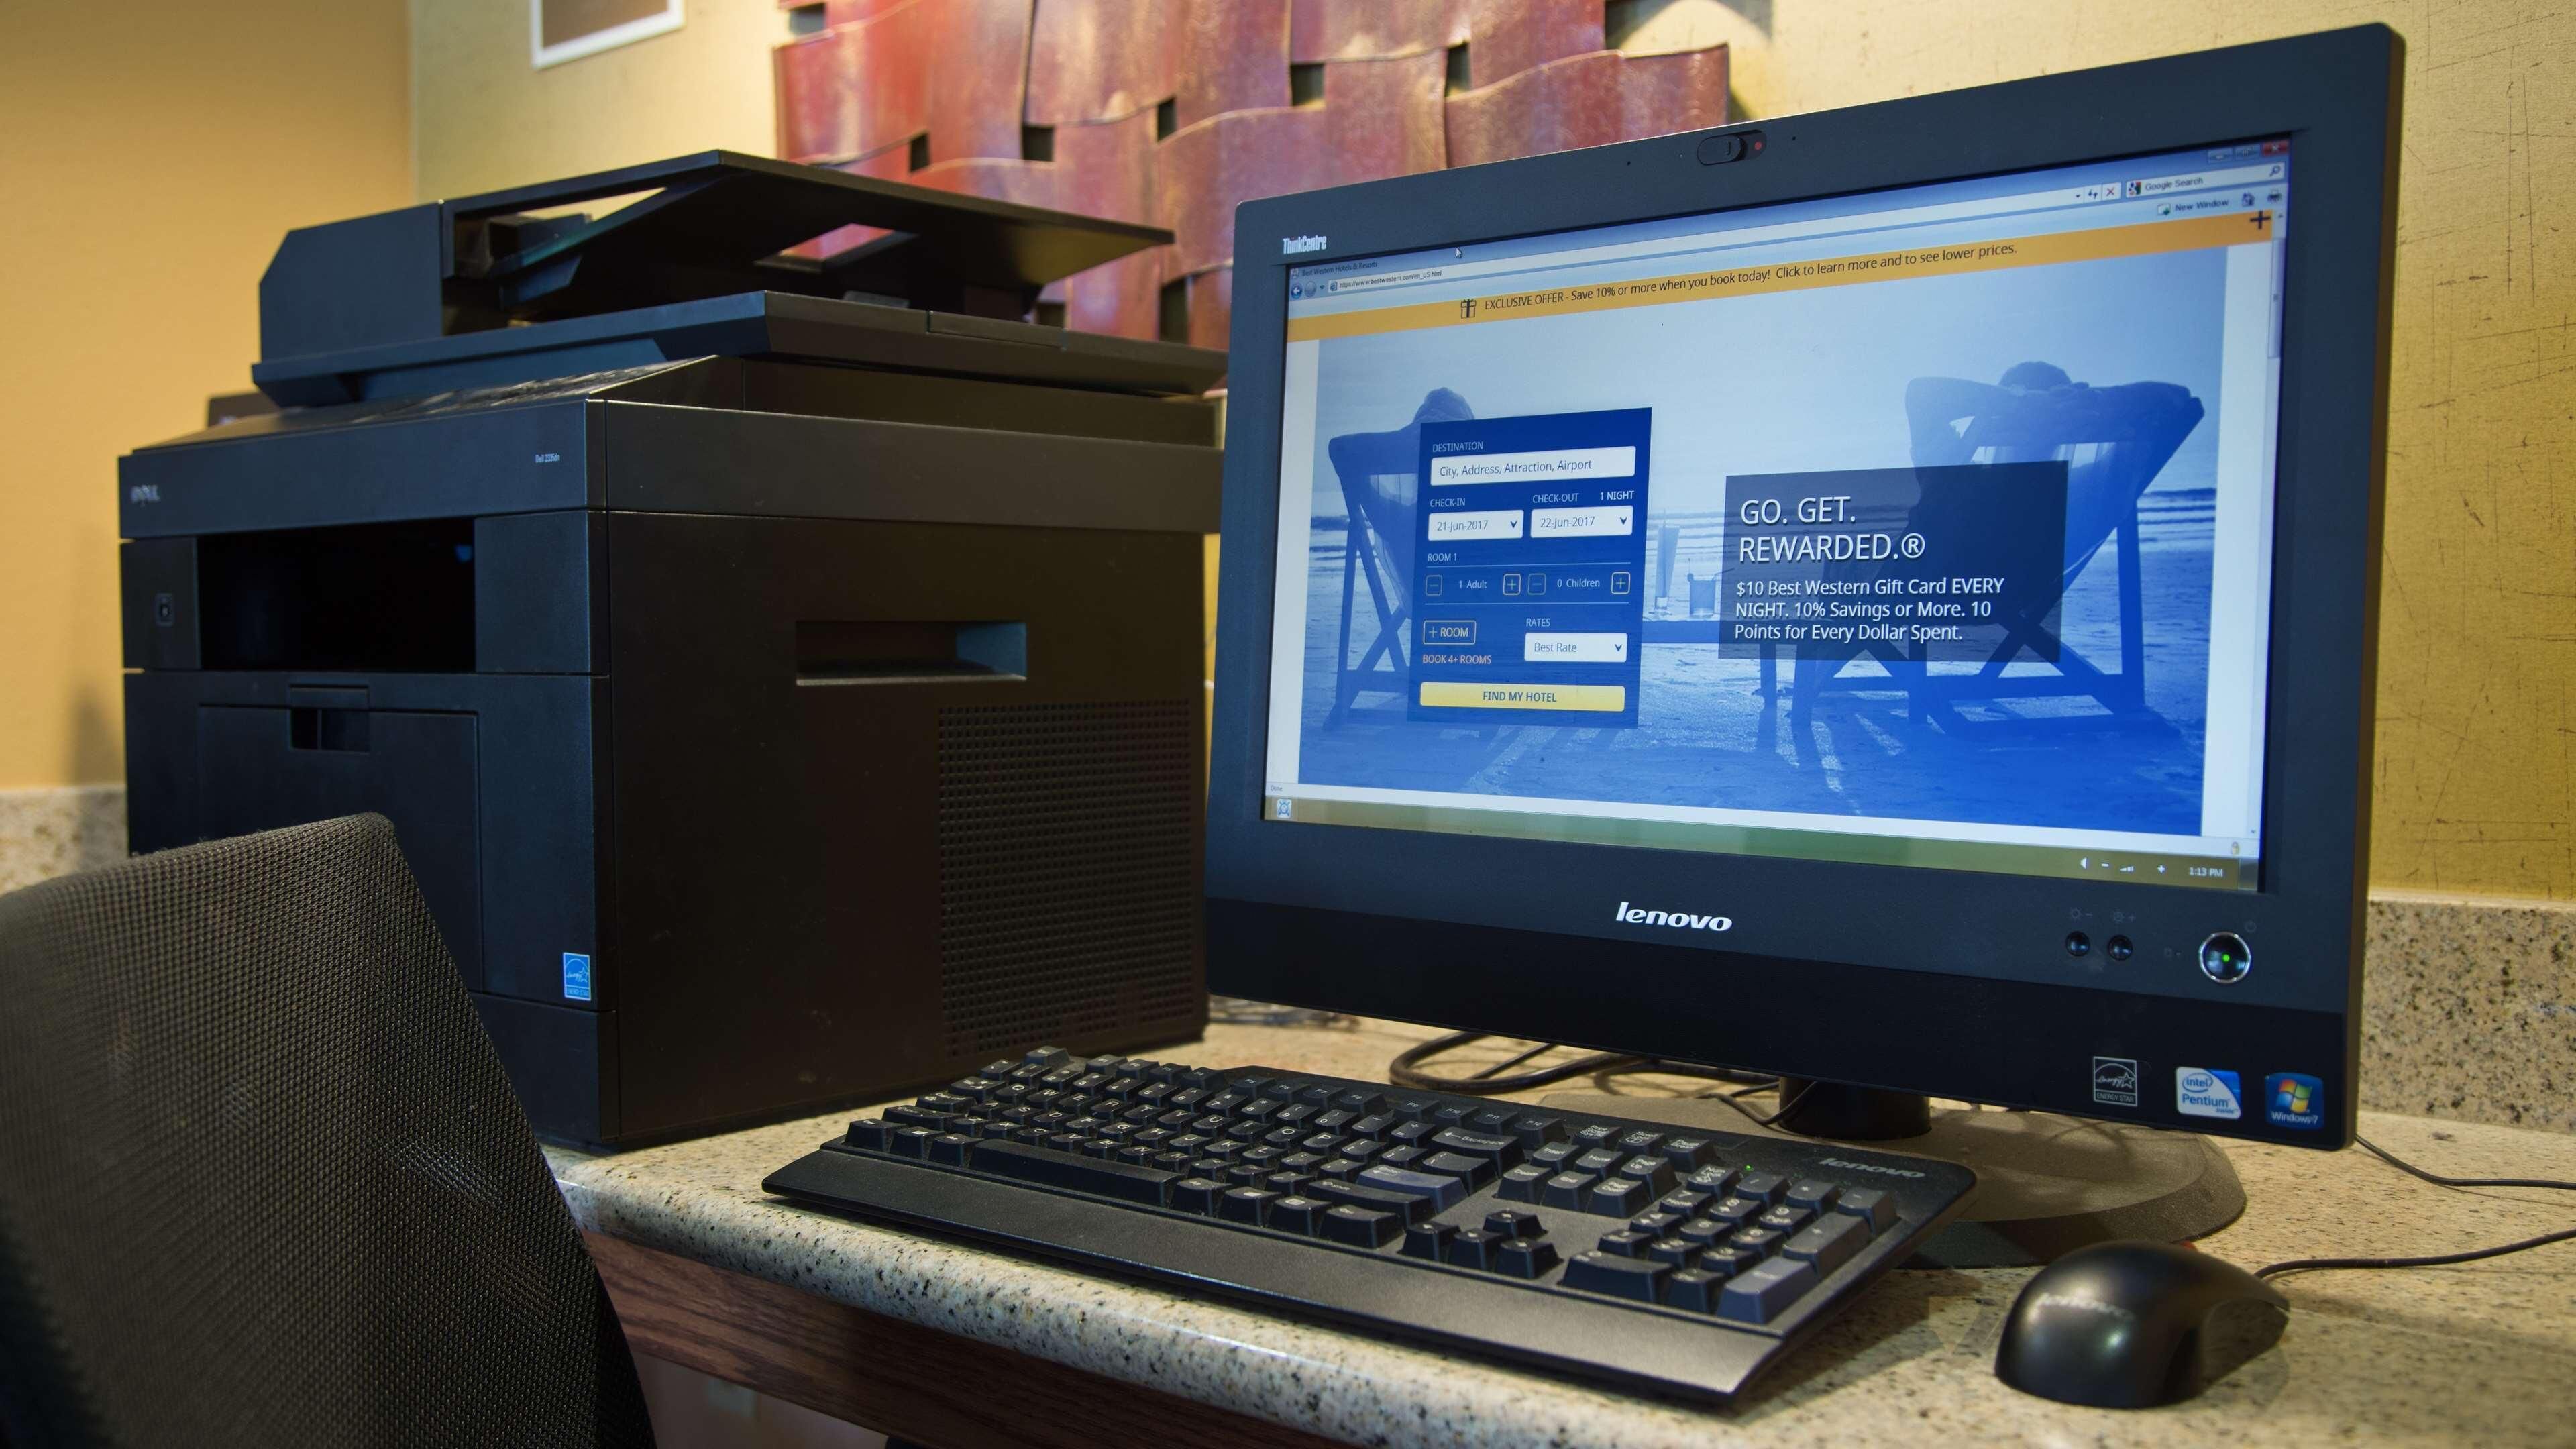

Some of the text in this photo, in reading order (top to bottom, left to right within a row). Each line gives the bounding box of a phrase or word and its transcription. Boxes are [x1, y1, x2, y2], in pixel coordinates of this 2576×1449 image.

[2145, 177, 2204, 192] Google Search
[2175, 198, 2229, 212] New Window
[1283, 235, 1327, 255] ThinkCentre
[1485, 295, 1532, 310] EXCLUSIVE
[1534, 292, 1564, 306] OFFER
[1571, 288, 1593, 301] Save
[1595, 286, 1615, 299] 10%
[1617, 286, 1628, 296] or
[1630, 282, 1658, 295] more
[1659, 277, 1686, 292] when
[1688, 276, 1707, 291] you
[1709, 272, 1736, 286] book
[1737, 268, 1771, 285] today!
[1776, 265, 1801, 279] Click
[1803, 264, 1815, 276] to
[1817, 261, 1845, 275] learn
[1847, 258, 1878, 272] more
[1880, 255, 1902, 268] and
[1904, 253, 1917, 265] to
[1919, 250, 1940, 264] see
[1942, 247, 1976, 261] lower
[1978, 242, 2018, 259] prices.
[1432, 441, 1484, 453] DESTINATION
[1439, 459, 1593, 479] City, Address, Attraction, Airport
[1532, 492, 1580, 504] CHECK-OUT
[1599, 490, 1635, 501] 1 NIGHT
[1430, 498, 1466, 508] CHECK-IN
[1740, 496, 1856, 525] GO. GET.
[1436, 520, 1489, 532] 21-Jun-2017
[1540, 516, 1595, 529] 22-Jun-2017
[1427, 553, 1457, 563] ROOM 1
[1466, 580, 1487, 589] Adult
[1556, 578, 1601, 588] 0 Children
[1736, 577, 2004, 598] $10 Best Western Gift Card EVERY
[1735, 601, 1991, 621] NIGHT. 10% Savings or More. 10
[1525, 618, 1551, 627] RATES
[1440, 627, 1469, 638] ROOM
[1735, 624, 1963, 644] Points for Every Dollar Spent.
[1534, 643, 1577, 653] Best Rate
[1422, 654, 1492, 665] BOOK 4+ ROOMS
[1483, 691, 1557, 702] FIND MY HOTEL
[2189, 867, 2224, 877] 1:13 PM
[1615, 901, 1733, 932] lenovo
[2186, 1077, 2208, 1087] intel
[2097, 1093, 2134, 1103] ENERGY STAR
[1819, 1158, 1926, 1179] lenovo
